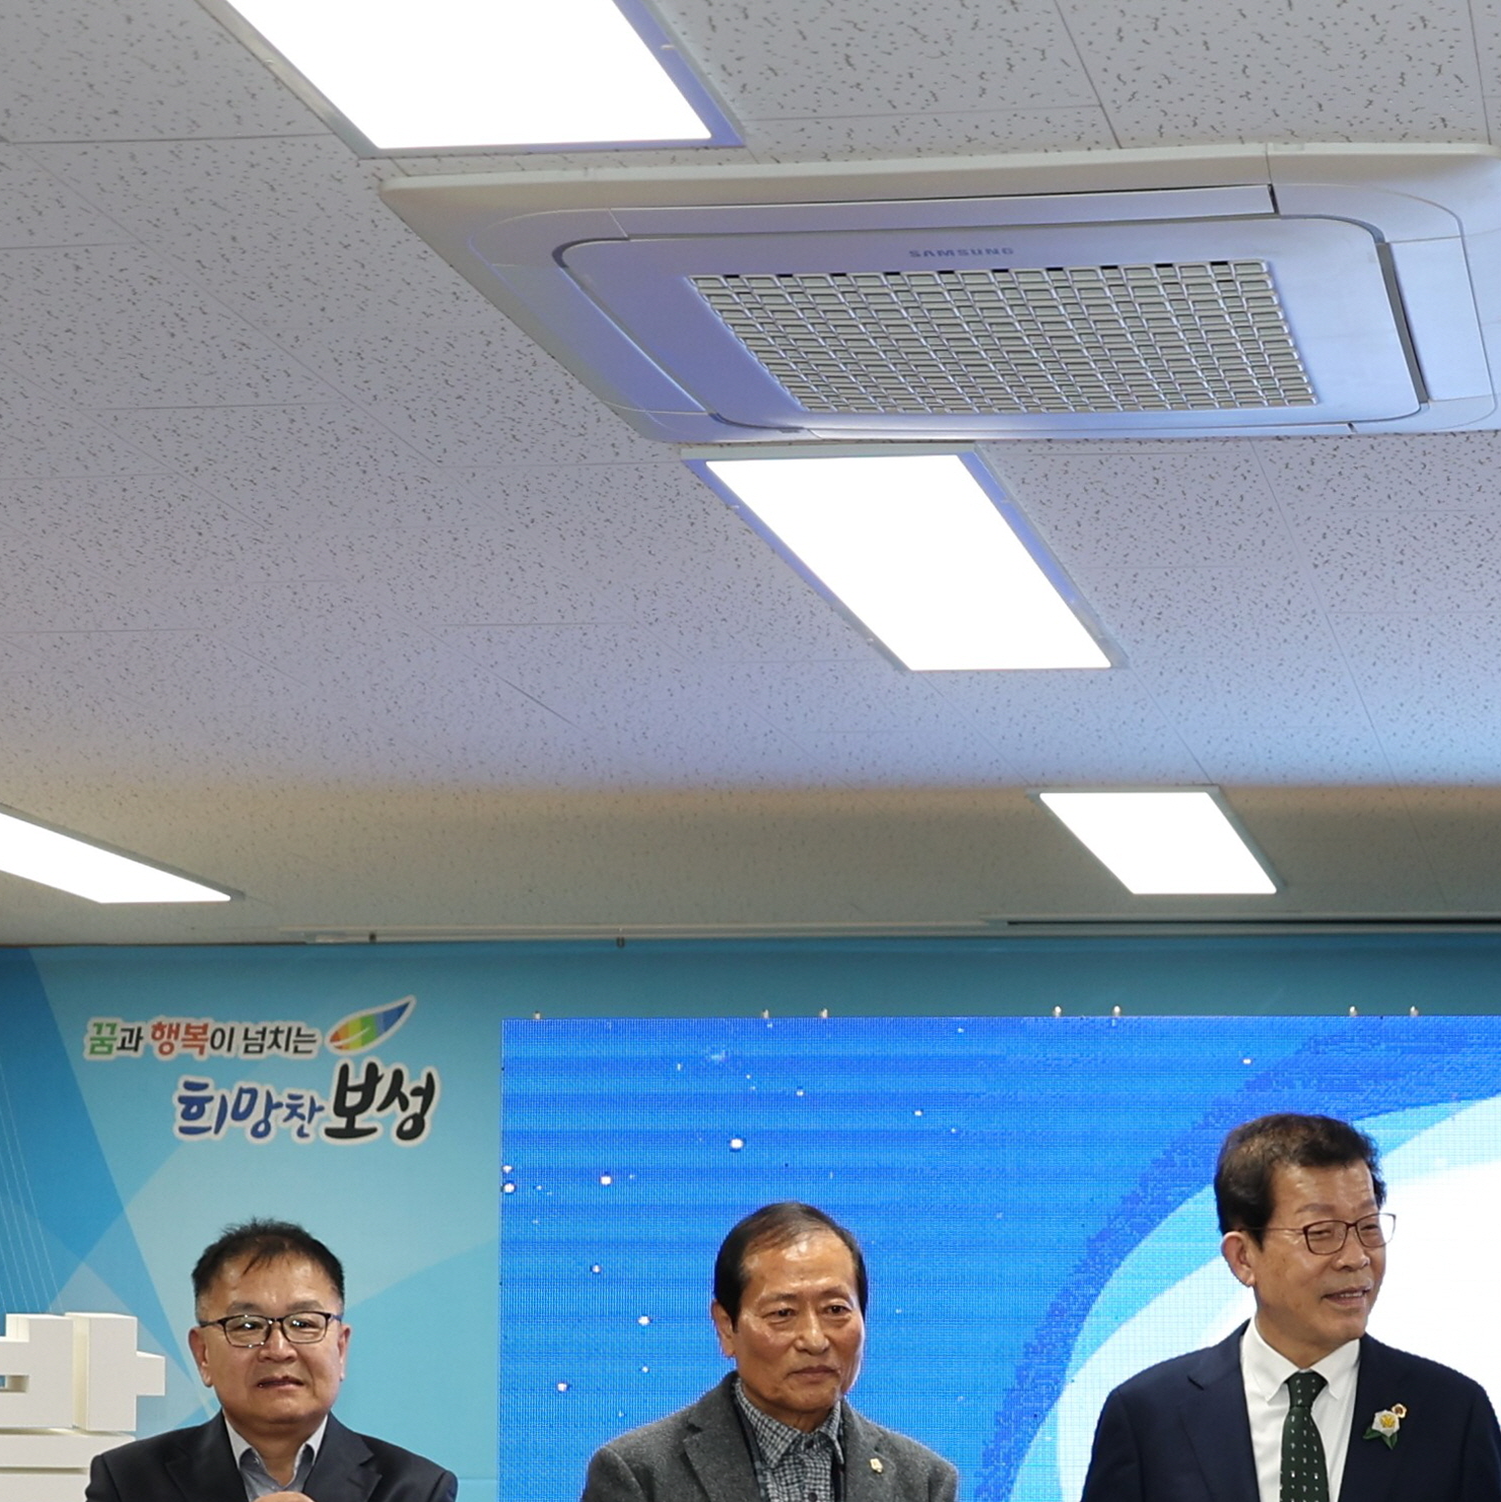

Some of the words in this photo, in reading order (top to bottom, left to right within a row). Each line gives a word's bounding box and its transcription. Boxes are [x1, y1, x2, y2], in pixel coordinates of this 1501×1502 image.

[908, 247, 1015, 258] SAMSUNG
[89, 1022, 144, 1055] 꿈과
[151, 1022, 235, 1056] 행복이
[242, 1025, 317, 1055] 넘치는
[177, 1080, 325, 1139] 희망찬
[324, 1061, 436, 1142] 보성
